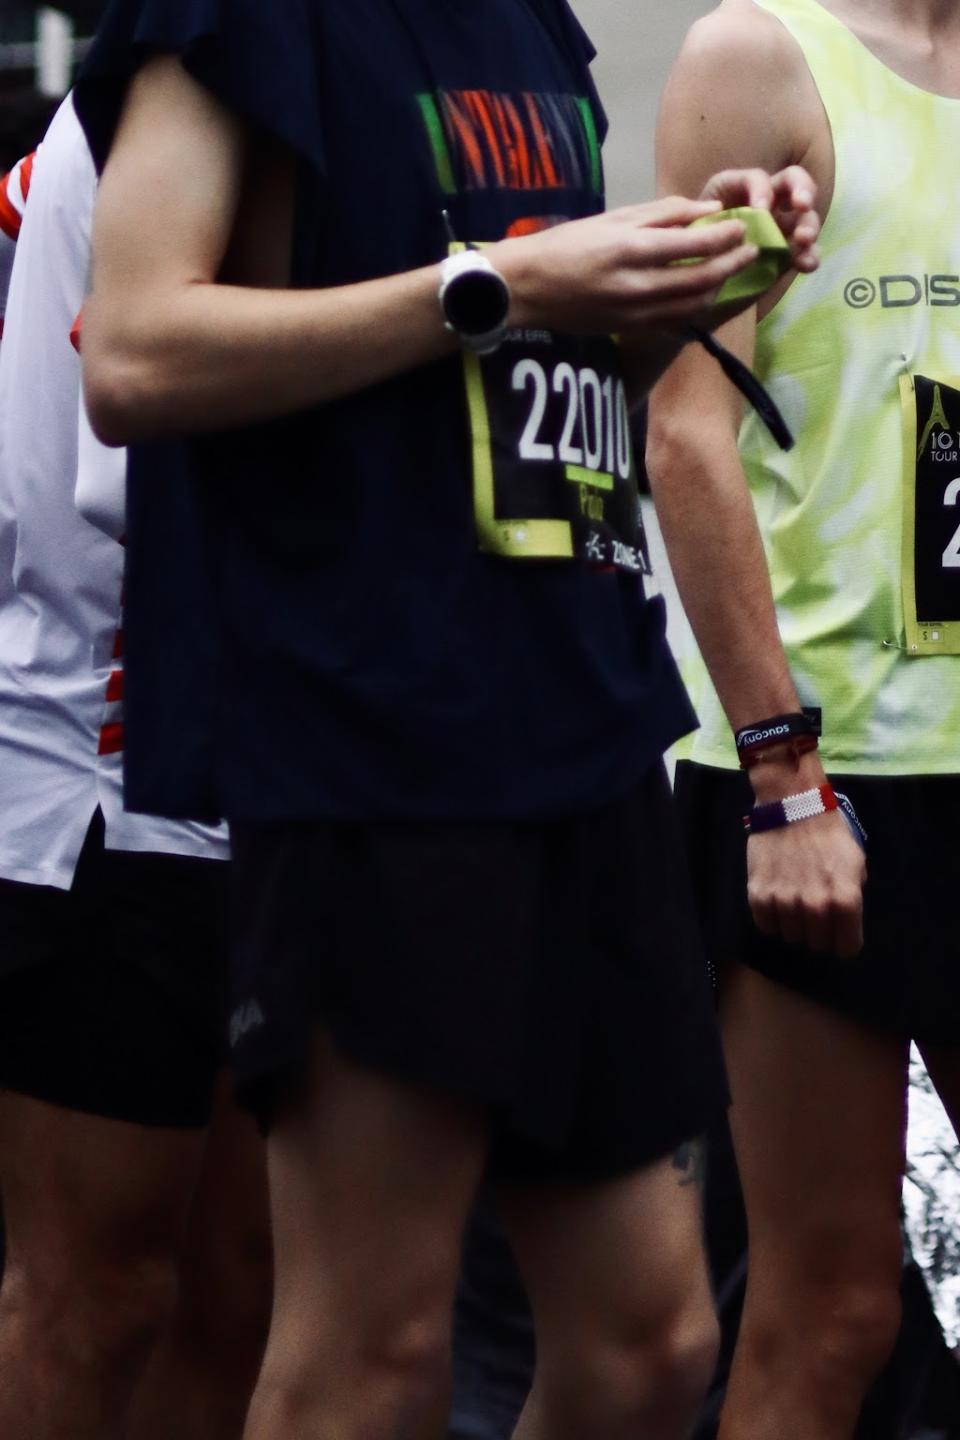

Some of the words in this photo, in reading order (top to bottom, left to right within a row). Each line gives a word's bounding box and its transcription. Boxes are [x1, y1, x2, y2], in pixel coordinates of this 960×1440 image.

[511, 357, 631, 480] 22010
[931, 431, 954, 449] 10
[931, 450, 958, 462] TOUR
[743, 723, 790, 746] saucony
